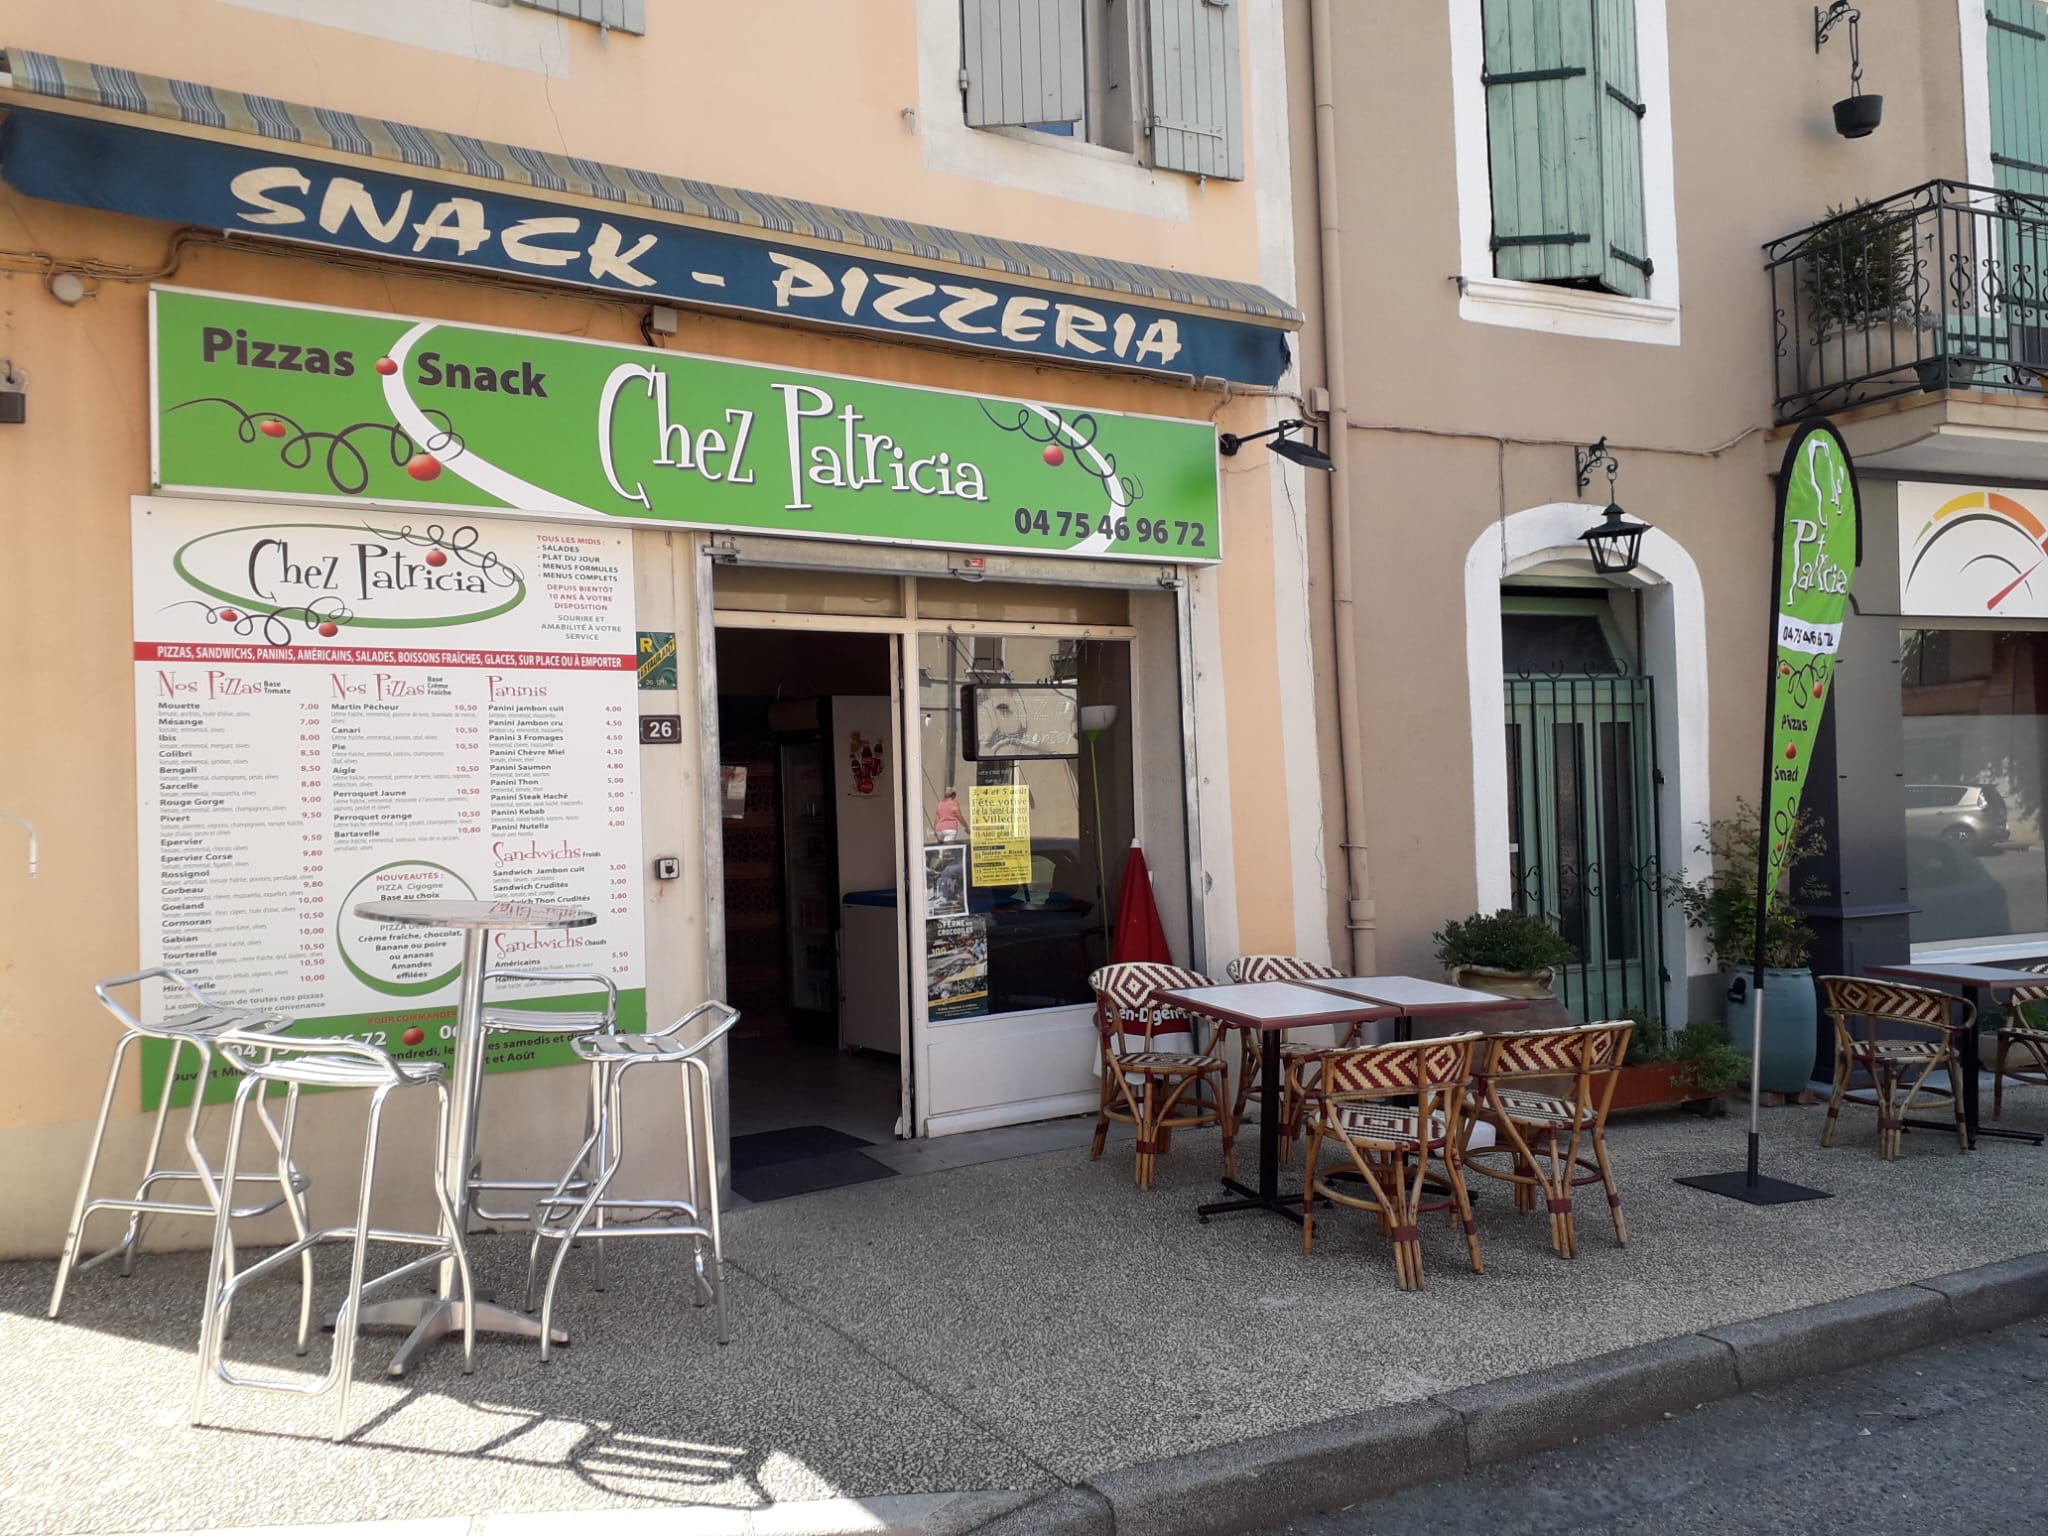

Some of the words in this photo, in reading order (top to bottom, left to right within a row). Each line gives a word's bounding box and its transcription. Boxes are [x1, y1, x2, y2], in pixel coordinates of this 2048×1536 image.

[230, 167, 657, 287] SNACK
[768, 252, 1182, 364] PIZZERIA
[202, 327, 355, 376] Pizzas
[418, 352, 548, 398] Snack
[598, 363, 755, 510] Chez
[771, 384, 990, 510] Patricia
[1014, 507, 1050, 537] 04
[1056, 511, 1091, 539] 75
[1098, 514, 1130, 541] 46
[1136, 517, 1169, 544] 96
[1174, 521, 1206, 547] 72
[248, 538, 339, 603] Chez
[350, 543, 487, 600] Patricia
[575, 564, 618, 573] FORMULES
[575, 573, 617, 582] COMPLETS
[579, 585, 613, 593] BIENTÔT
[640, 637, 653, 653] R
[157, 646, 194, 658] PIZZAS,
[196, 647, 255, 660] SANDWICHS,
[257, 648, 295, 661] PANINIS,
[298, 648, 354, 662] AMÉRICAINS,
[355, 650, 396, 664] SALADES,
[398, 651, 440, 663] BOISSONS
[442, 651, 483, 665] FRAÎCHES,
[485, 654, 517, 666] GLACES,
[519, 655, 534, 666] SUR
[536, 656, 560, 666] PLACE
[561, 657, 573, 666] OU
[575, 655, 581, 666] À
[581, 657, 621, 668] EMPORTER
[156, 670, 198, 699] Nos
[205, 671, 262, 700] Pizzas
[329, 673, 366, 700] Nos
[372, 674, 425, 700] Pizzas
[486, 675, 547, 702] Paninis
[363, 703, 399, 711] Pêcheur
[158, 718, 203, 726] Mésange
[650, 721, 672, 737] 26
[159, 767, 197, 775] Bengali
[160, 799, 192, 807] Rouge
[194, 798, 224, 806] Gorge
[334, 814, 379, 822] Perroquet
[381, 813, 412, 821] orange
[334, 830, 380, 838] Bartavelle
[161, 838, 203, 847] Epervier
[161, 854, 202, 863] Epervier
[205, 853, 233, 861] Corse
[493, 840, 581, 868] Sandwichs
[161, 870, 210, 880] Rossignol
[376, 873, 439, 881] NOUVEAUTÉS
[161, 886, 203, 894] Corbeau
[407, 883, 443, 891] Cigogne
[162, 903, 204, 911] Goeland
[162, 918, 212, 927] Cormoran
[162, 935, 198, 943] Gabian
[495, 930, 583, 959] Sandwichs
[163, 950, 217, 959] Tourterelle
[495, 959, 540, 967] Américains
[274, 1002, 325, 1011] convenance
[503, 1038, 550, 1049] samedis
[554, 1035, 564, 1043] et
[492, 1055, 504, 1064] et
